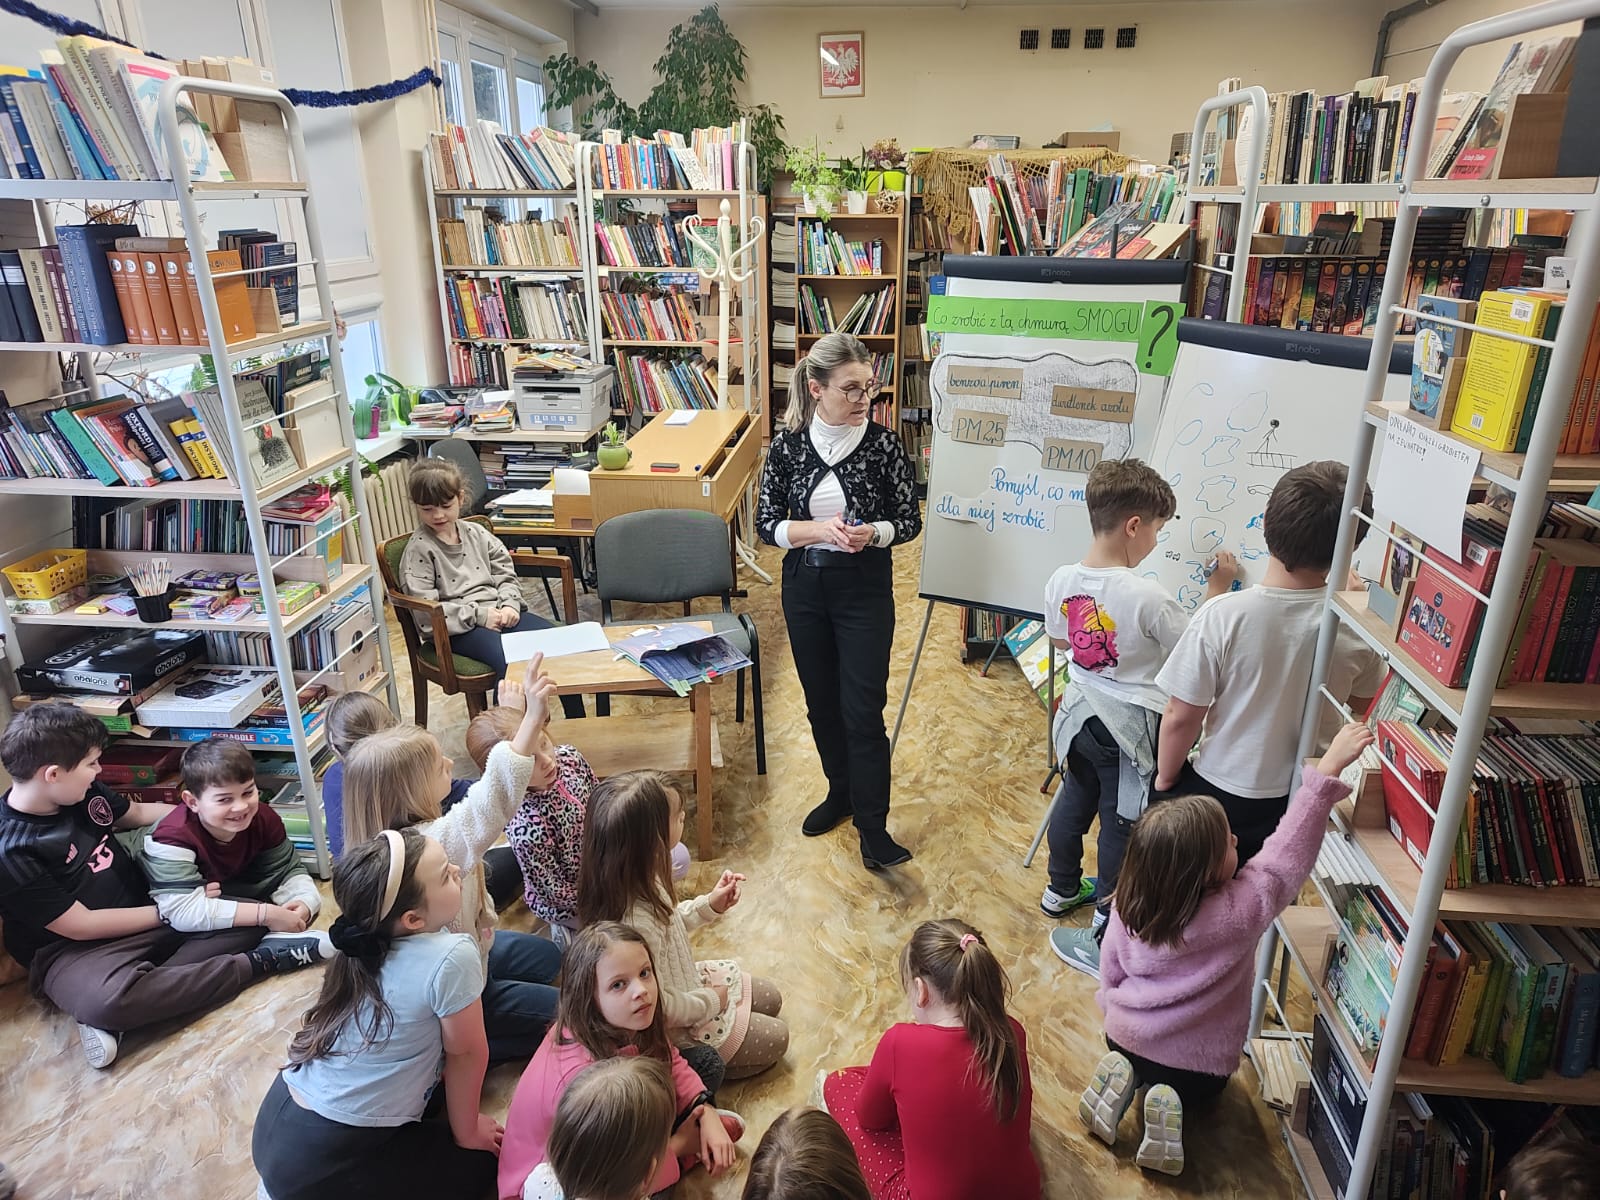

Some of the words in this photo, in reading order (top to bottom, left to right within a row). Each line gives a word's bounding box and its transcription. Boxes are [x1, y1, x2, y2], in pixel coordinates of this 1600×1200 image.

[933, 308, 948, 324] Co
[951, 307, 986, 328] zrobić
[990, 317, 996, 327] z
[1000, 308, 1014, 331] tą
[1018, 310, 1069, 334] chmurą
[1075, 308, 1140, 334] SMOGU
[129, 412, 153, 444] OXFORD
[202, 441, 221, 475] ANGIELSKI
[1047, 488, 1064, 500] co
[936, 495, 961, 516] dla
[968, 500, 996, 533] niej
